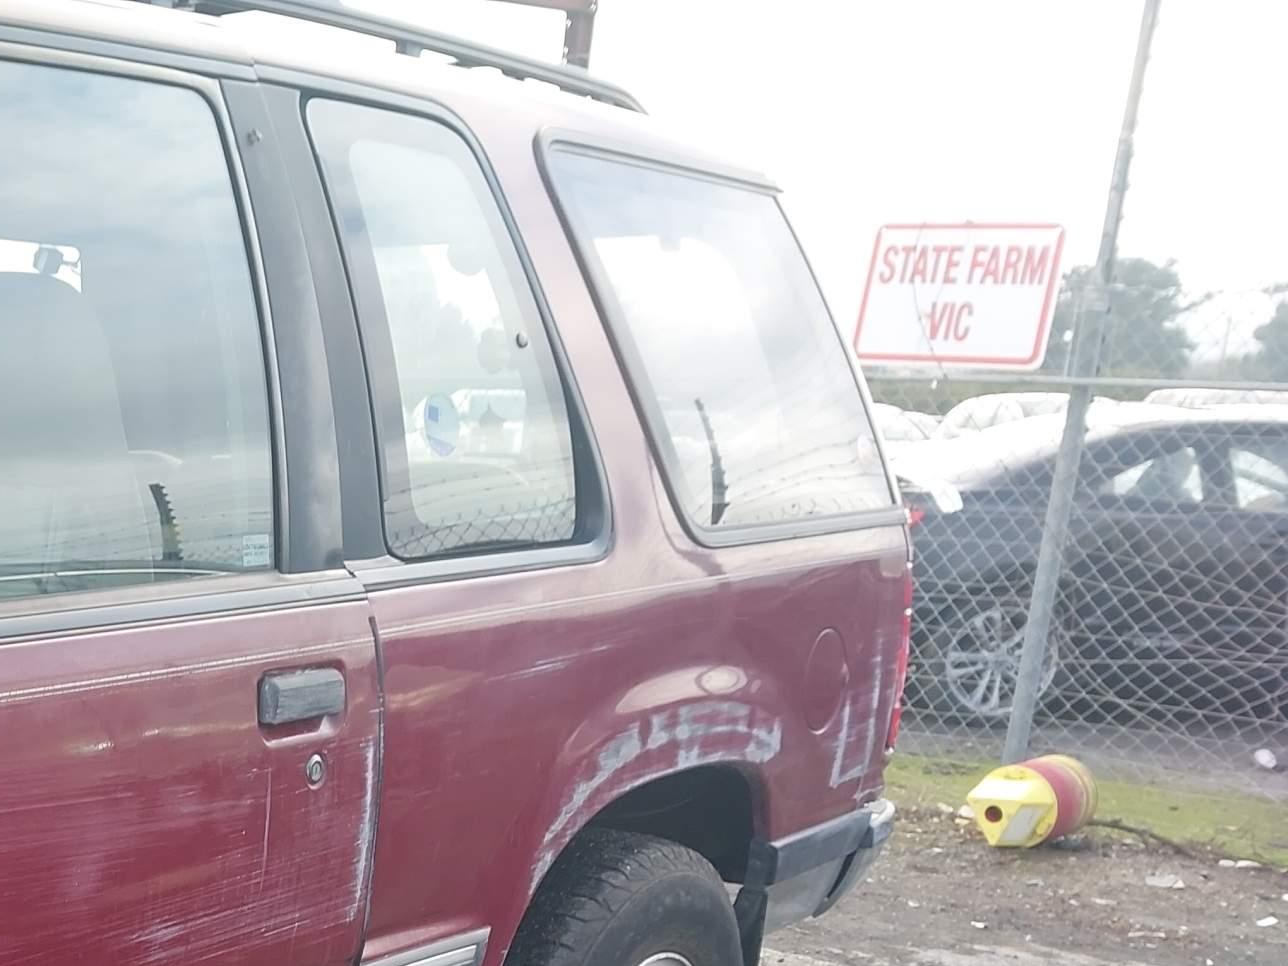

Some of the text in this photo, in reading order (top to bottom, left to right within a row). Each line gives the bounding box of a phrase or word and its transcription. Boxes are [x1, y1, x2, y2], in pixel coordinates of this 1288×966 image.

[878, 245, 1051, 285] STATE FARM
[928, 302, 973, 341] VIC
